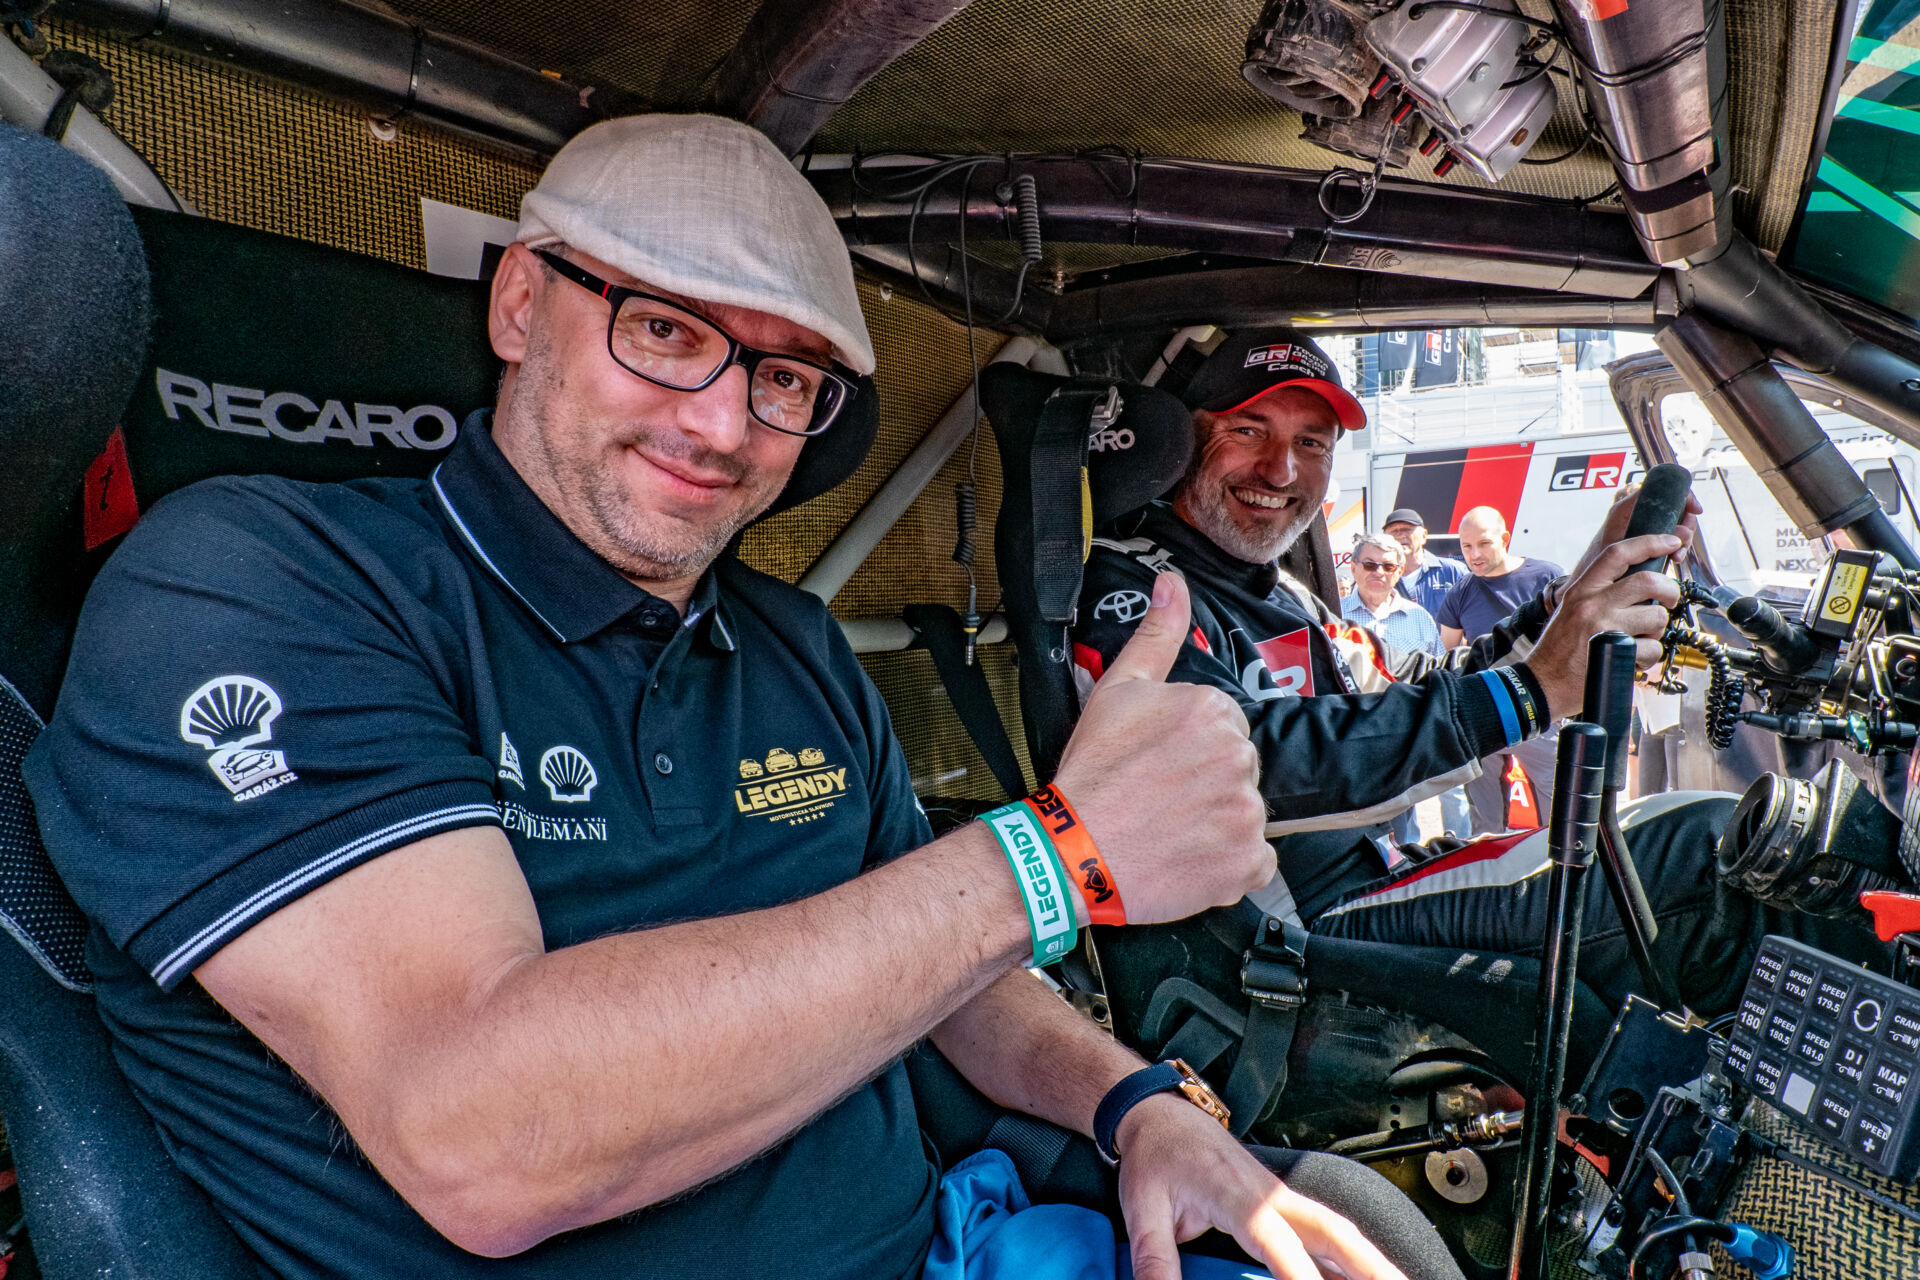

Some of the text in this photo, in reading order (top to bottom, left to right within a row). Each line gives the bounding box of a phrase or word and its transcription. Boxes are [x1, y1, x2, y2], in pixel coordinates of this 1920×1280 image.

[1248, 347, 1288, 363] GR
[1267, 362, 1315, 378] Czech
[156, 366, 458, 450] RECARO
[1088, 428, 1136, 452] ARO
[1550, 464, 1622, 491] GR
[233, 771, 298, 802] GARÁŽ.CZ
[734, 767, 847, 813] LEGENDY
[497, 806, 607, 841] ENTLEMANI
[1003, 820, 1061, 927] LEGENDY
[1760, 956, 1782, 971] SPEED
[1756, 967, 1776, 983] 178.5
[1789, 969, 1813, 985] SPEED
[1785, 982, 1807, 998] 179.0
[1820, 983, 1847, 1000] SPEED
[1743, 1000, 1766, 1015] SPEED
[1817, 996, 1841, 1012] 179.5
[1740, 1011, 1761, 1029] 180
[1773, 1016, 1796, 1032] SPEED
[1769, 1028, 1791, 1045] 180.5
[1804, 1031, 1830, 1049] SPEED
[1730, 1044, 1752, 1060] SPEED
[1801, 1044, 1824, 1062] 181.0
[1727, 1056, 1746, 1073] 181.5
[1758, 1060, 1781, 1078] SPEED
[1755, 1073, 1776, 1090] 182.0
[1877, 1065, 1907, 1087] MAP
[1823, 1098, 1850, 1118] SPEED
[1859, 1119, 1889, 1141] SPEED
